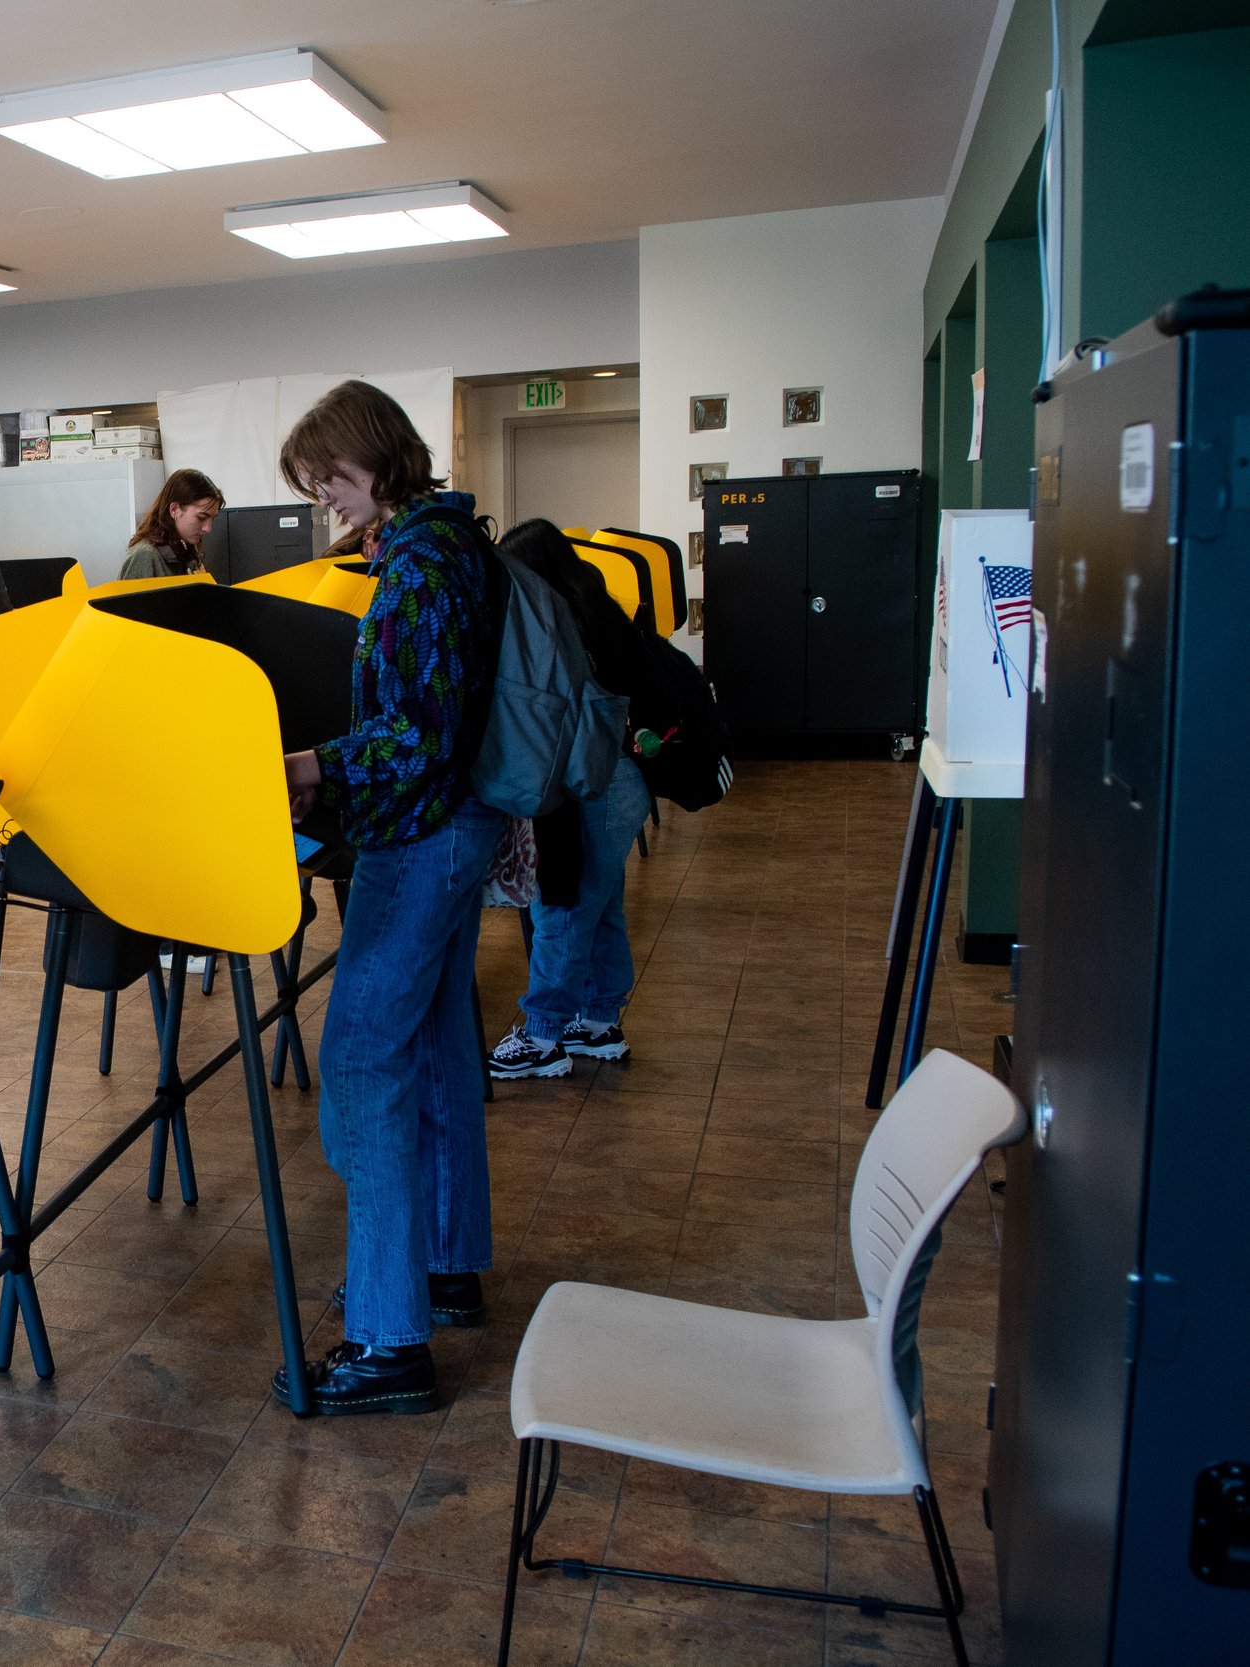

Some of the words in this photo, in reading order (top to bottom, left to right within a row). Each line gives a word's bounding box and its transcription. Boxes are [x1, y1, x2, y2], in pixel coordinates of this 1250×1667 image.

[526, 382, 557, 407] EXIT
[722, 494, 746, 504] PER
[752, 494, 765, 503] x5
